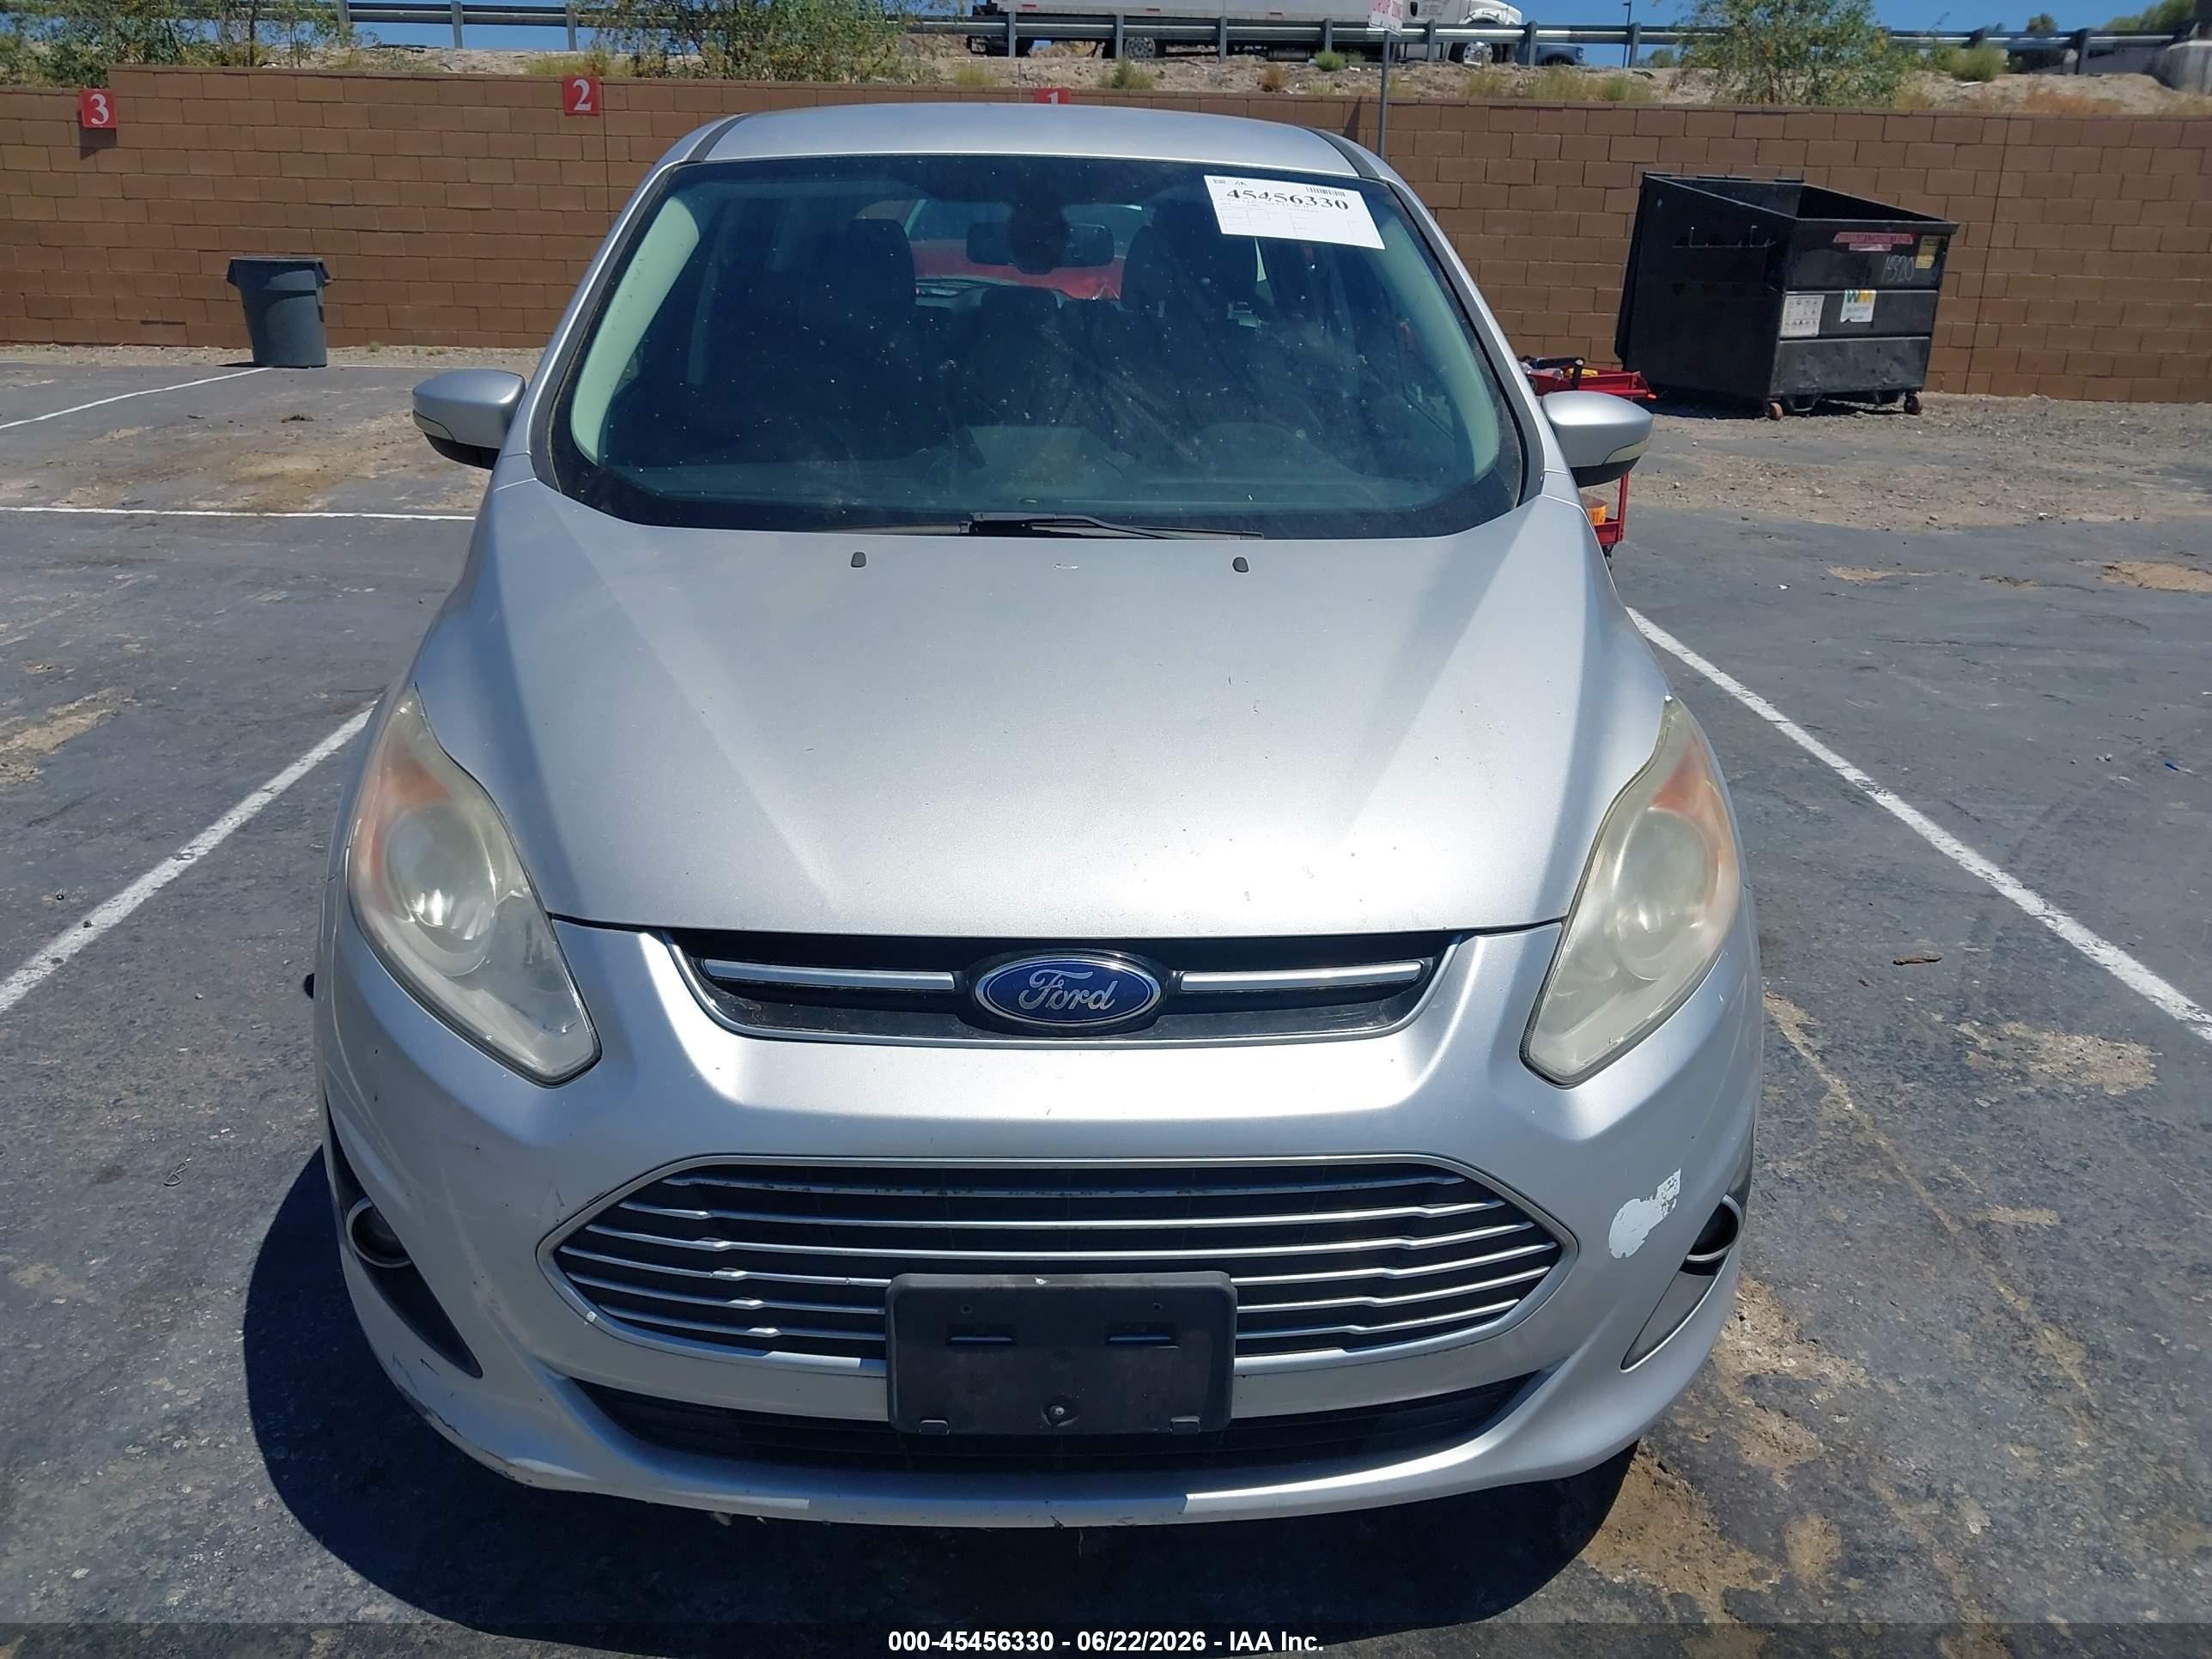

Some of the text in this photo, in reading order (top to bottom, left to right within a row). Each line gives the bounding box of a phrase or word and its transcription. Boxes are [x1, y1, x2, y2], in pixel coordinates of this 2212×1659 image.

[89, 94, 109, 124] 3
[573, 79, 592, 110] 2
[1226, 189, 1349, 210] 45456330
[1018, 969, 1118, 1010] Ford
